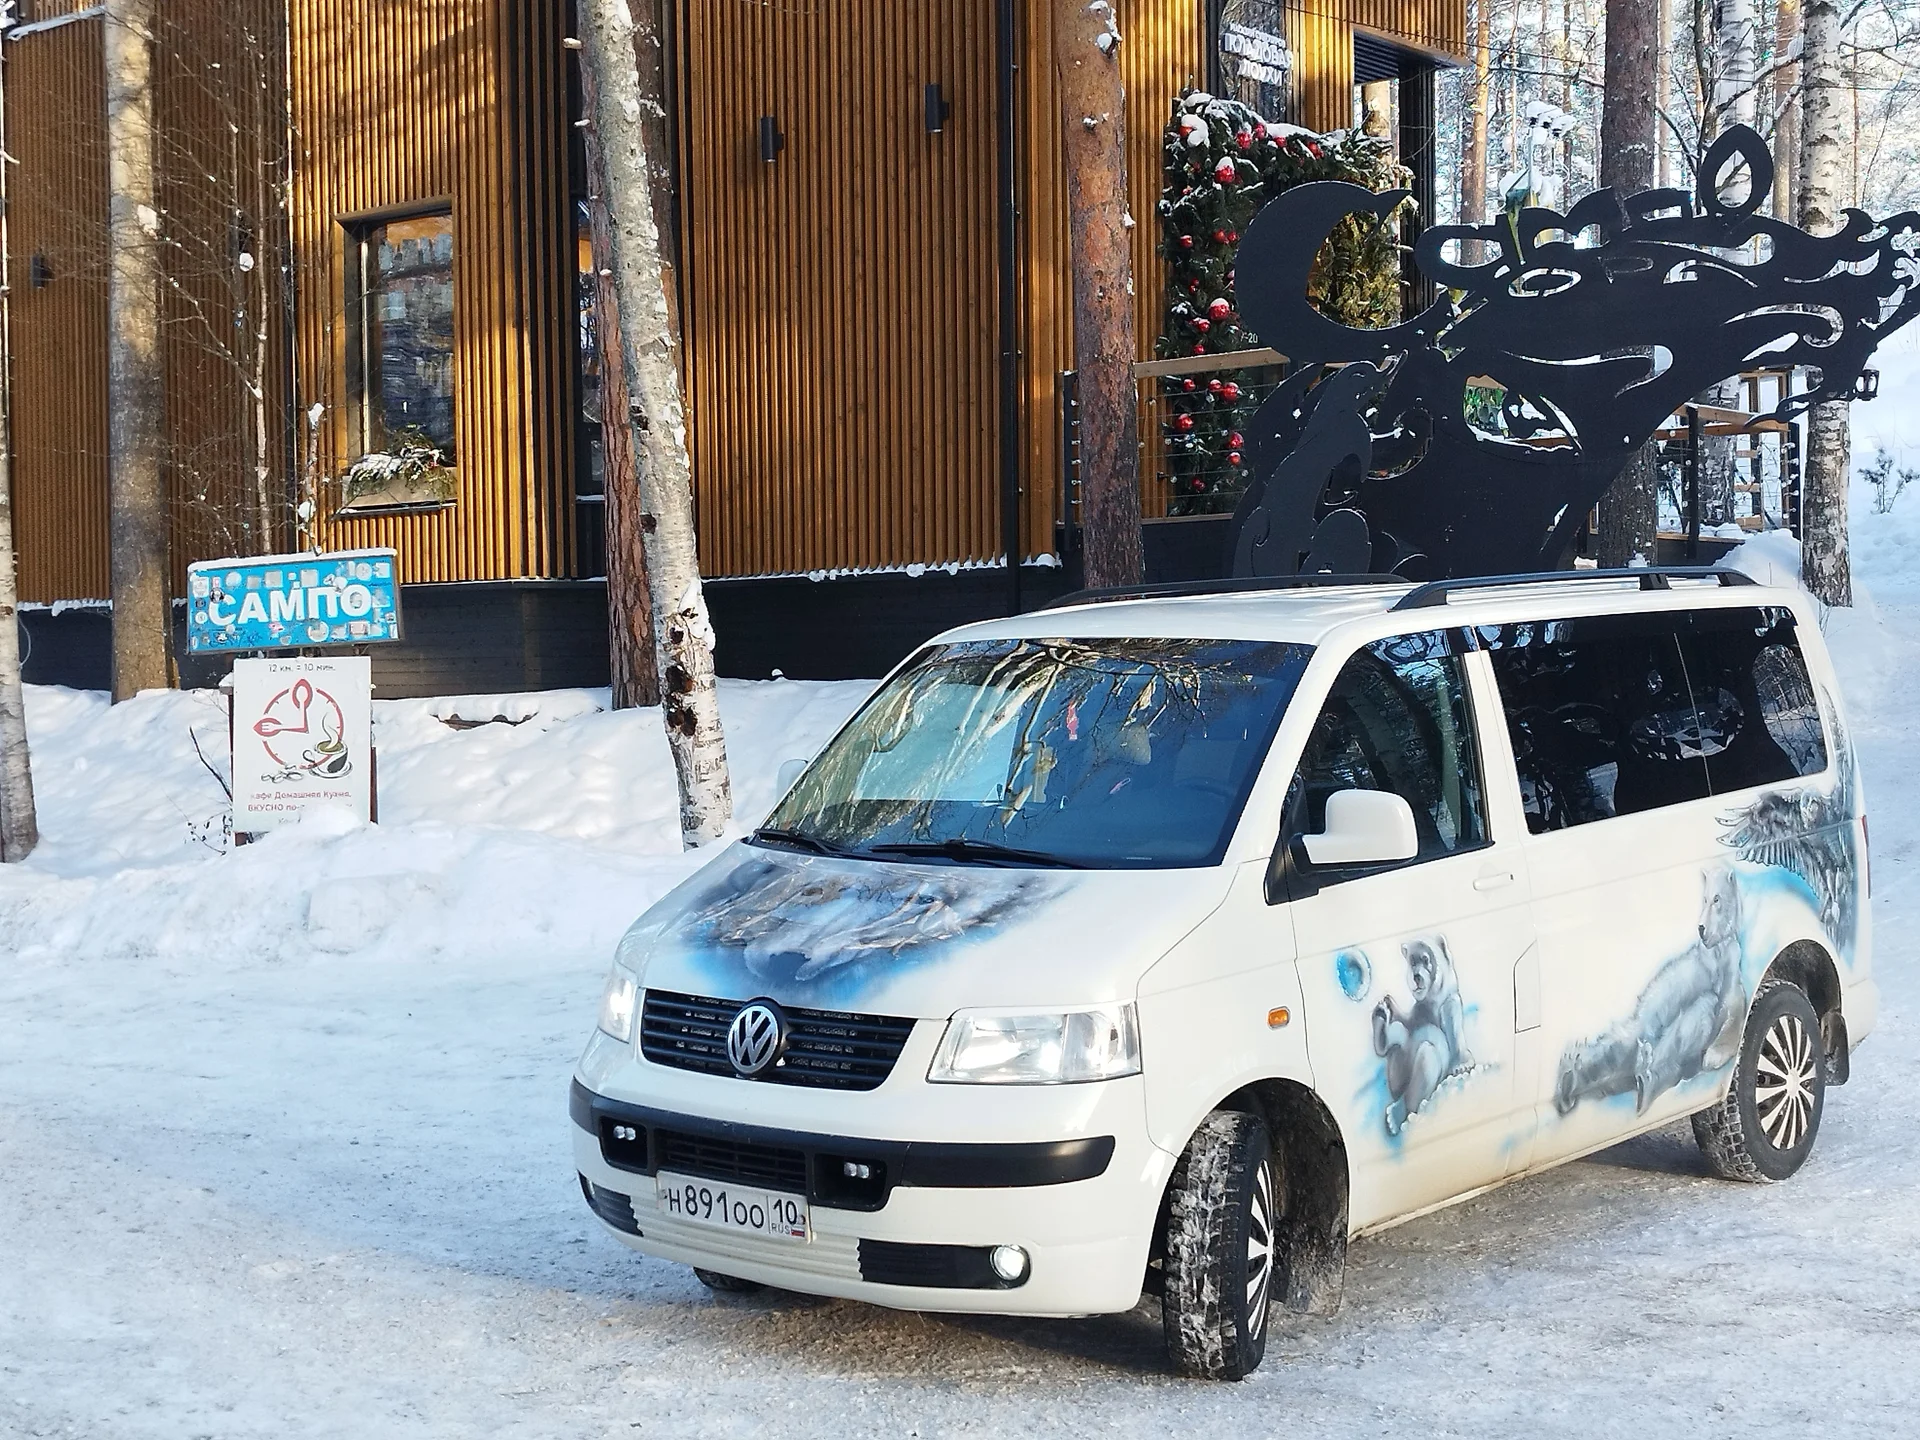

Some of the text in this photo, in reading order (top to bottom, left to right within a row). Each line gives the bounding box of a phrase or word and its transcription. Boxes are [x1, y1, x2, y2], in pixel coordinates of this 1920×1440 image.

[1224, 33, 1294, 70] КЛАДОВАЯ
[209, 584, 372, 626] САМПО
[304, 663, 314, 671] 10
[771, 1222, 791, 1235] RUS
